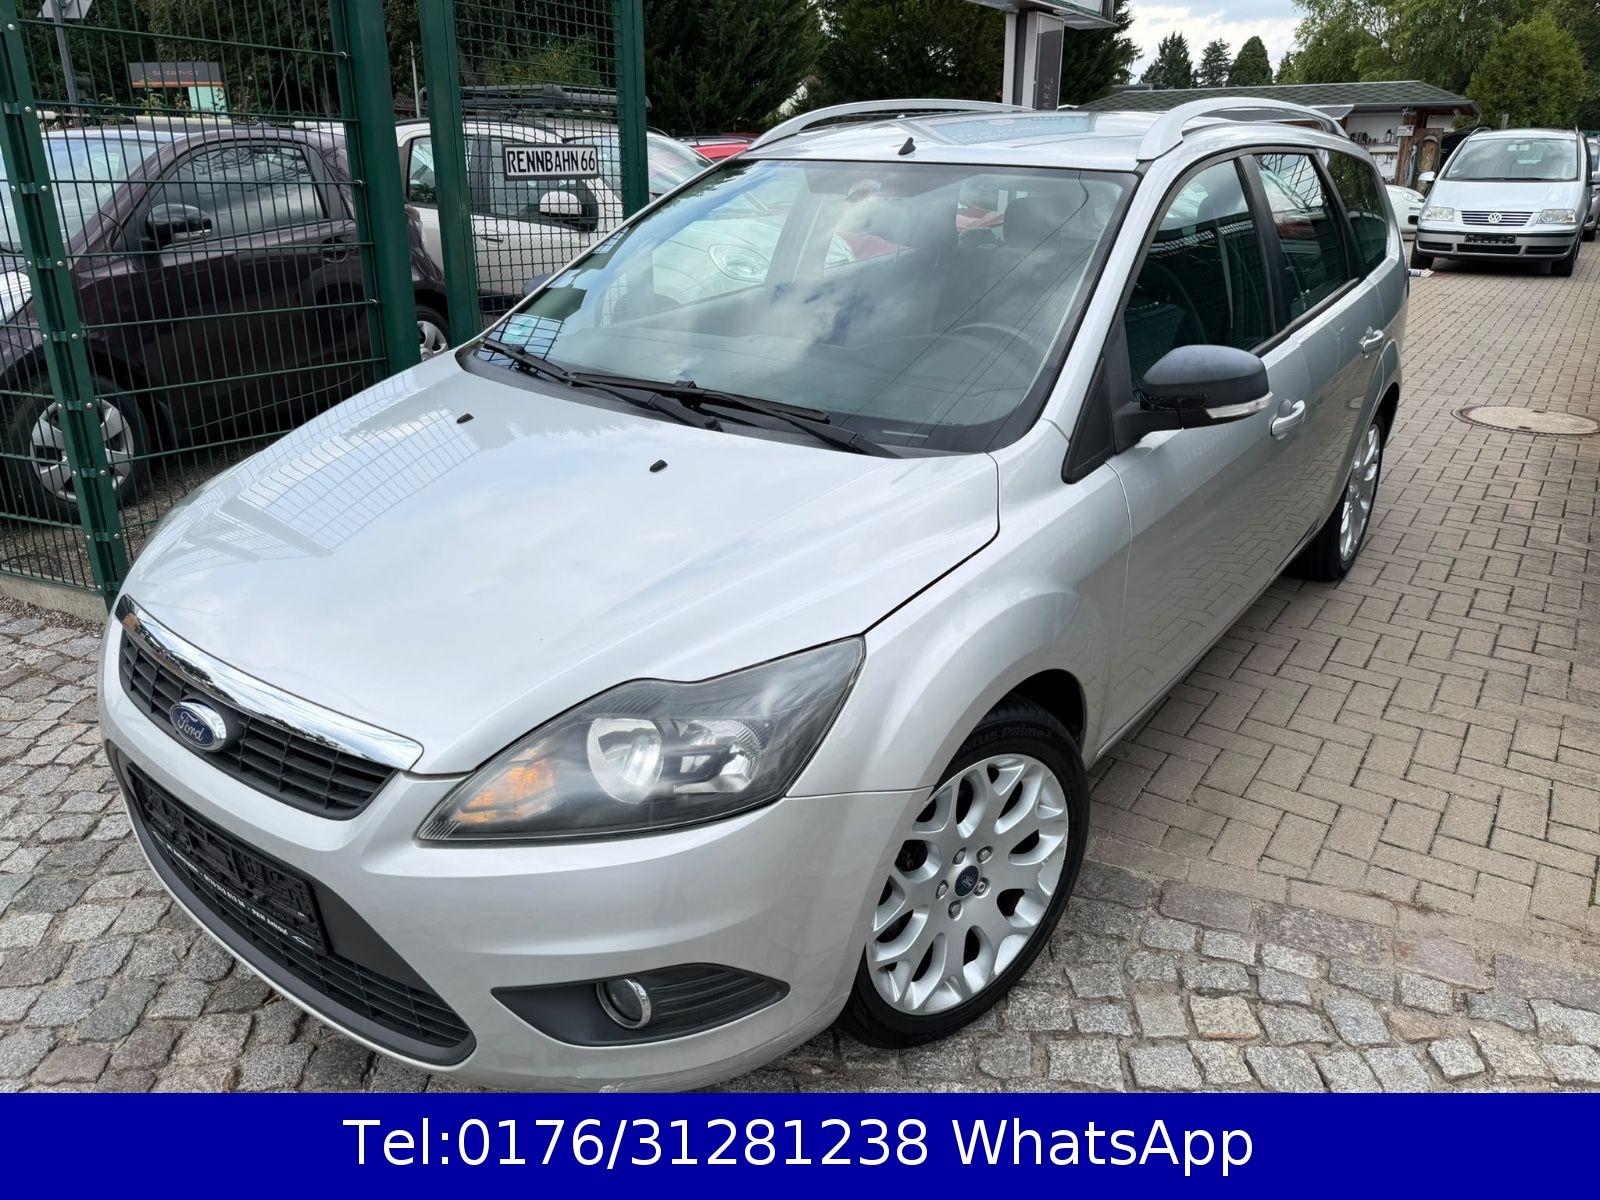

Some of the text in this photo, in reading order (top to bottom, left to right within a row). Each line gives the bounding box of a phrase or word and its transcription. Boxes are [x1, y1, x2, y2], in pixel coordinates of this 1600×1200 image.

[507, 150, 596, 173] RENNBAHN 66
[177, 711, 205, 742] Ford
